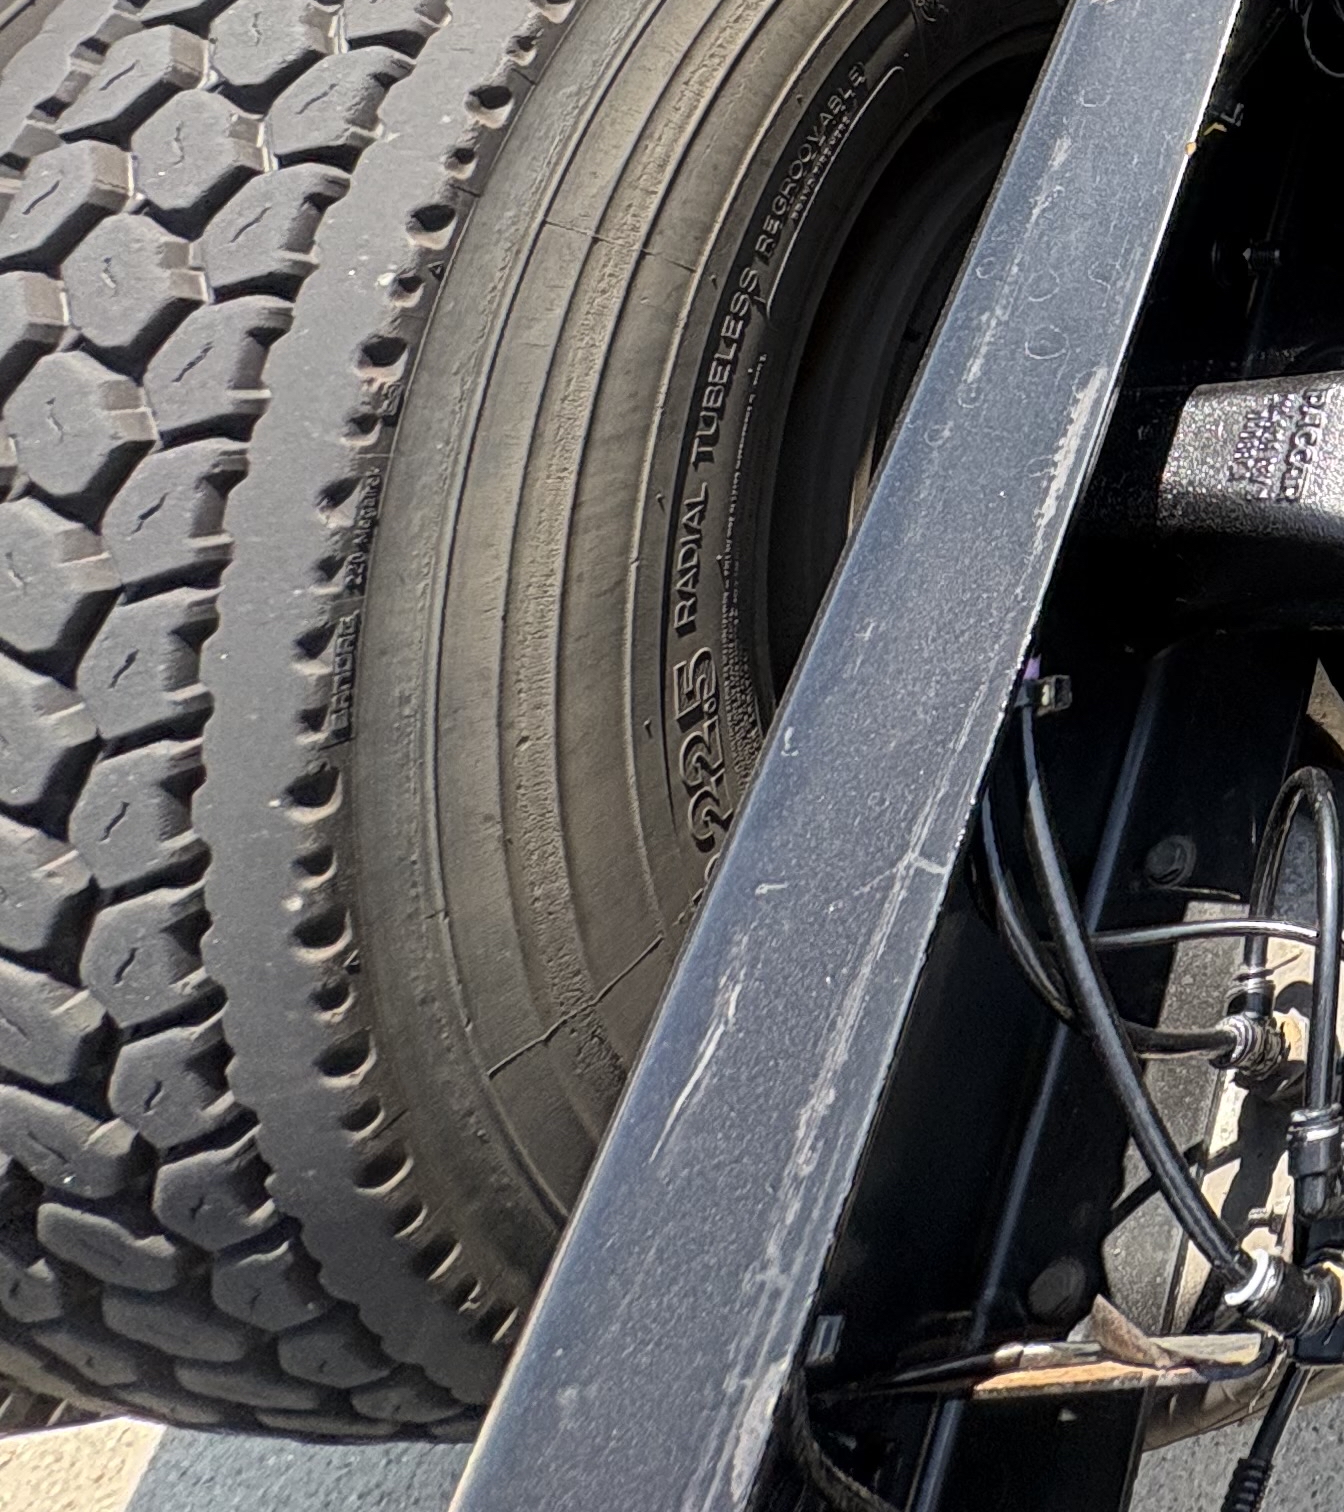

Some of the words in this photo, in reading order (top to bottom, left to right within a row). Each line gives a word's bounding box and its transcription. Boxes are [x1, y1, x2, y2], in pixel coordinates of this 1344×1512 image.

[755, 61, 867, 263] REGROOVABLE
[690, 266, 759, 466] TUBELESS
[673, 482, 708, 630] RADIAL
